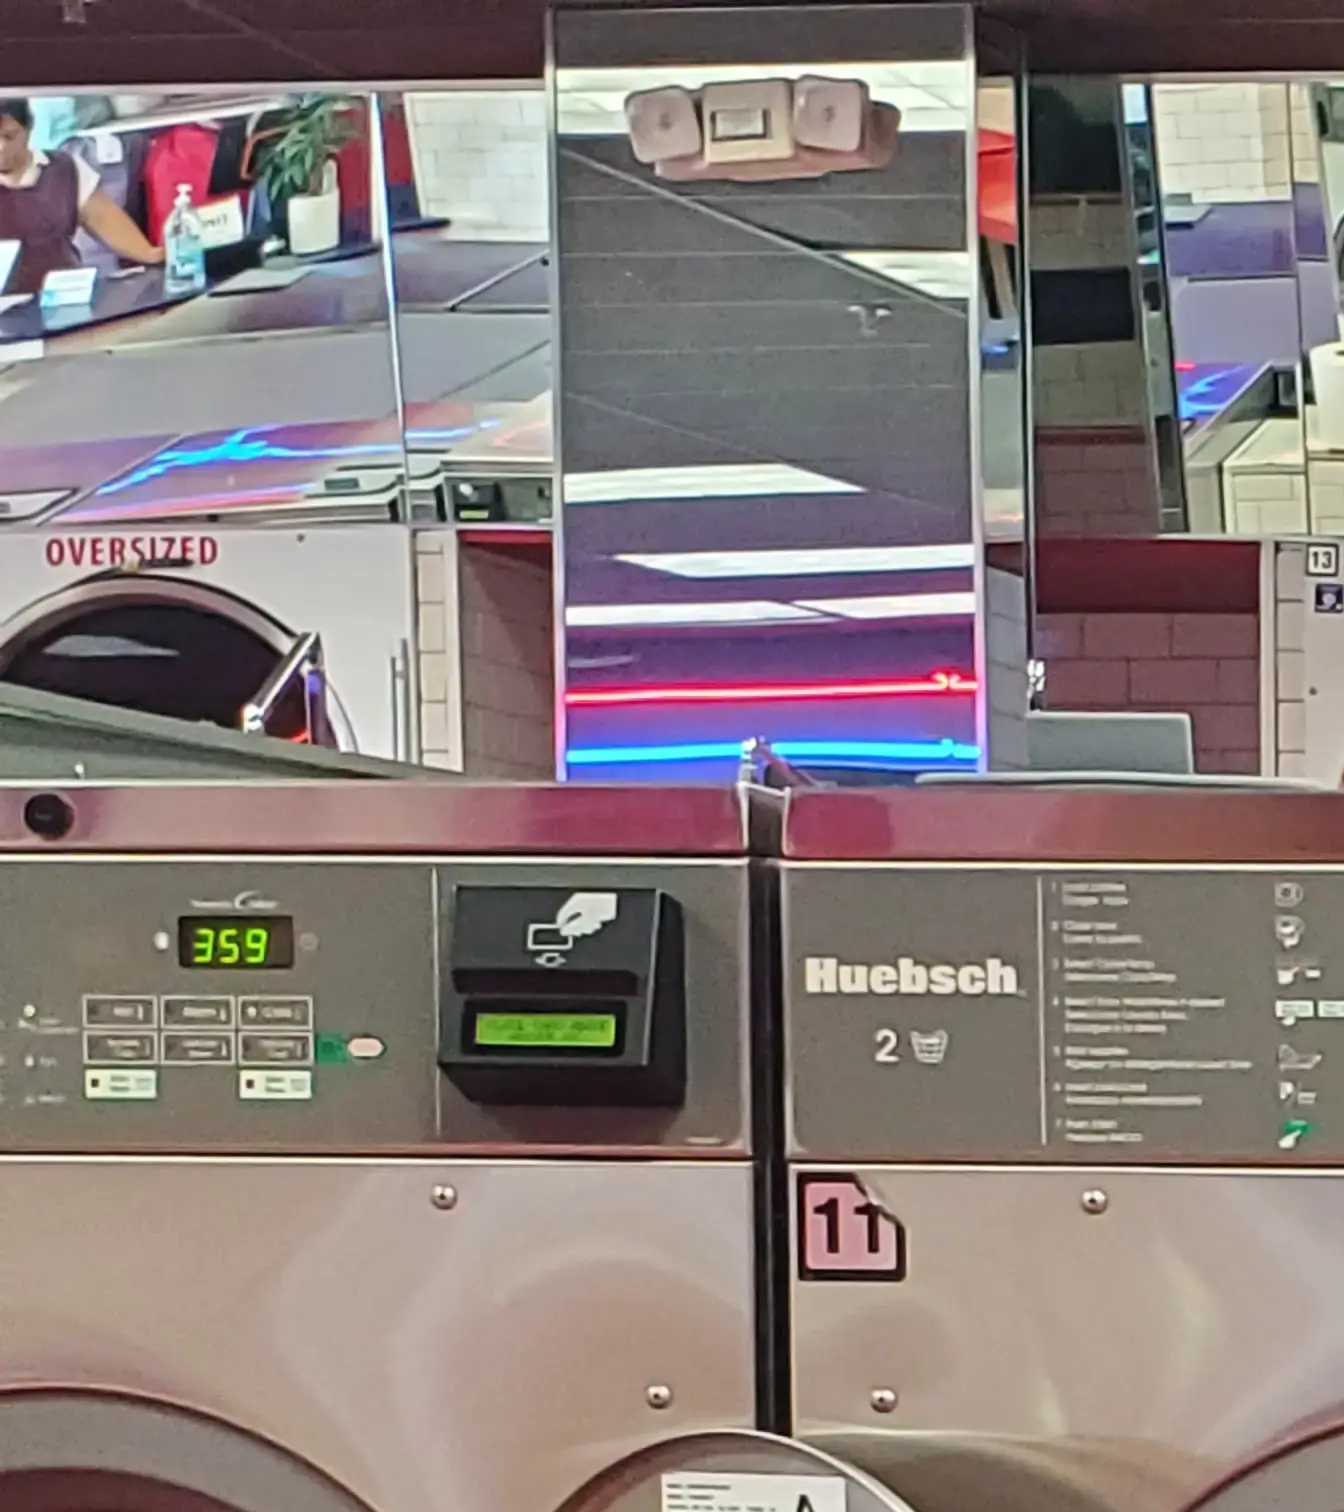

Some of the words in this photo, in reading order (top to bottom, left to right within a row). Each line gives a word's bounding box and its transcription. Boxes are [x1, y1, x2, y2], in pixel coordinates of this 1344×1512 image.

[46, 536, 219, 567] OVERSIZED
[1311, 550, 1333, 570] 13
[193, 928, 268, 964] 359
[805, 957, 1018, 994] Huebsch
[874, 1028, 899, 1062] 2
[813, 1197, 880, 1254] 11
